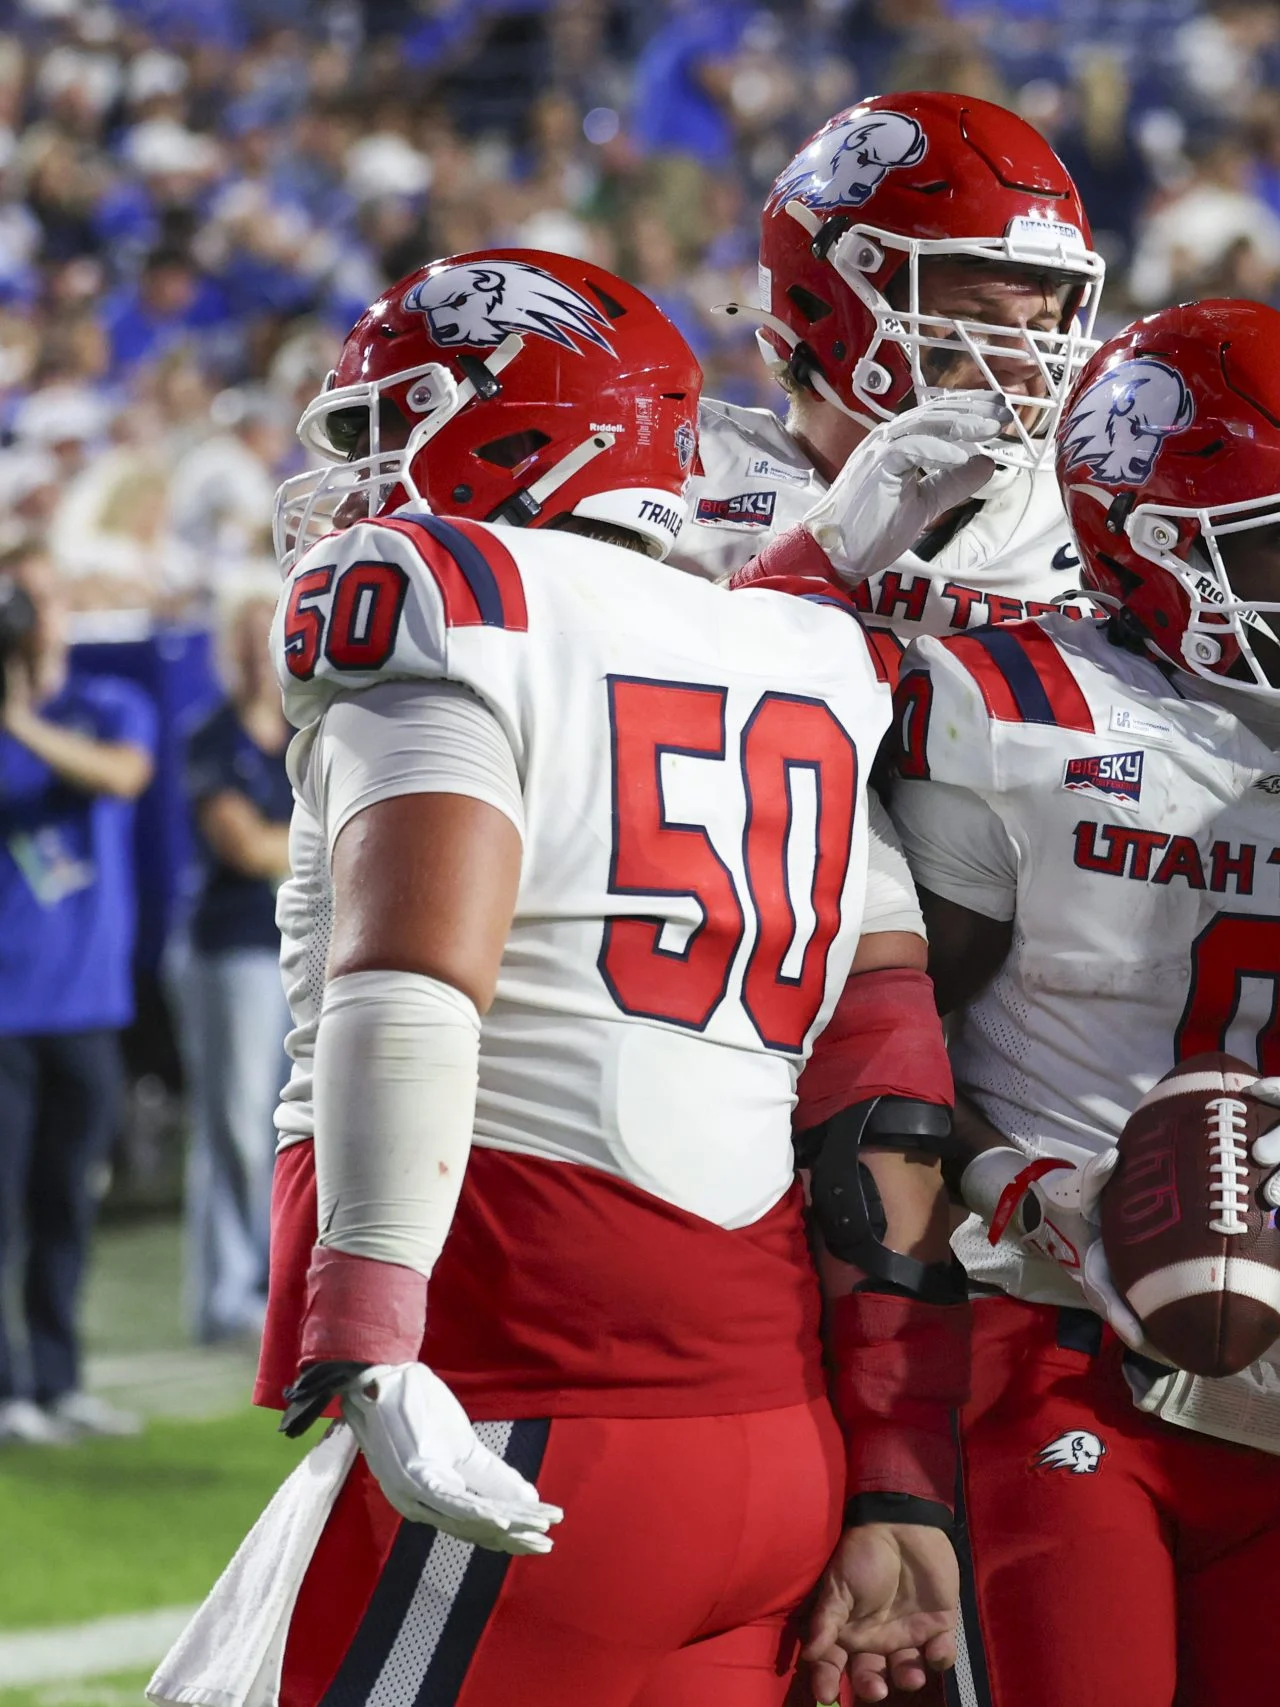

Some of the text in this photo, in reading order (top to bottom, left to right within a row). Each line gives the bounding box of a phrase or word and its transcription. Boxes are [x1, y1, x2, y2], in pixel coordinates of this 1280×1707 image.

[1052, 224, 1077, 239] TECH
[590, 423, 624, 433] Riddell
[728, 494, 773, 515] SKY
[285, 560, 410, 682] 50
[1098, 755, 1141, 782] SKY
[597, 673, 858, 1055] 50
[1072, 820, 1257, 895] UTAH
